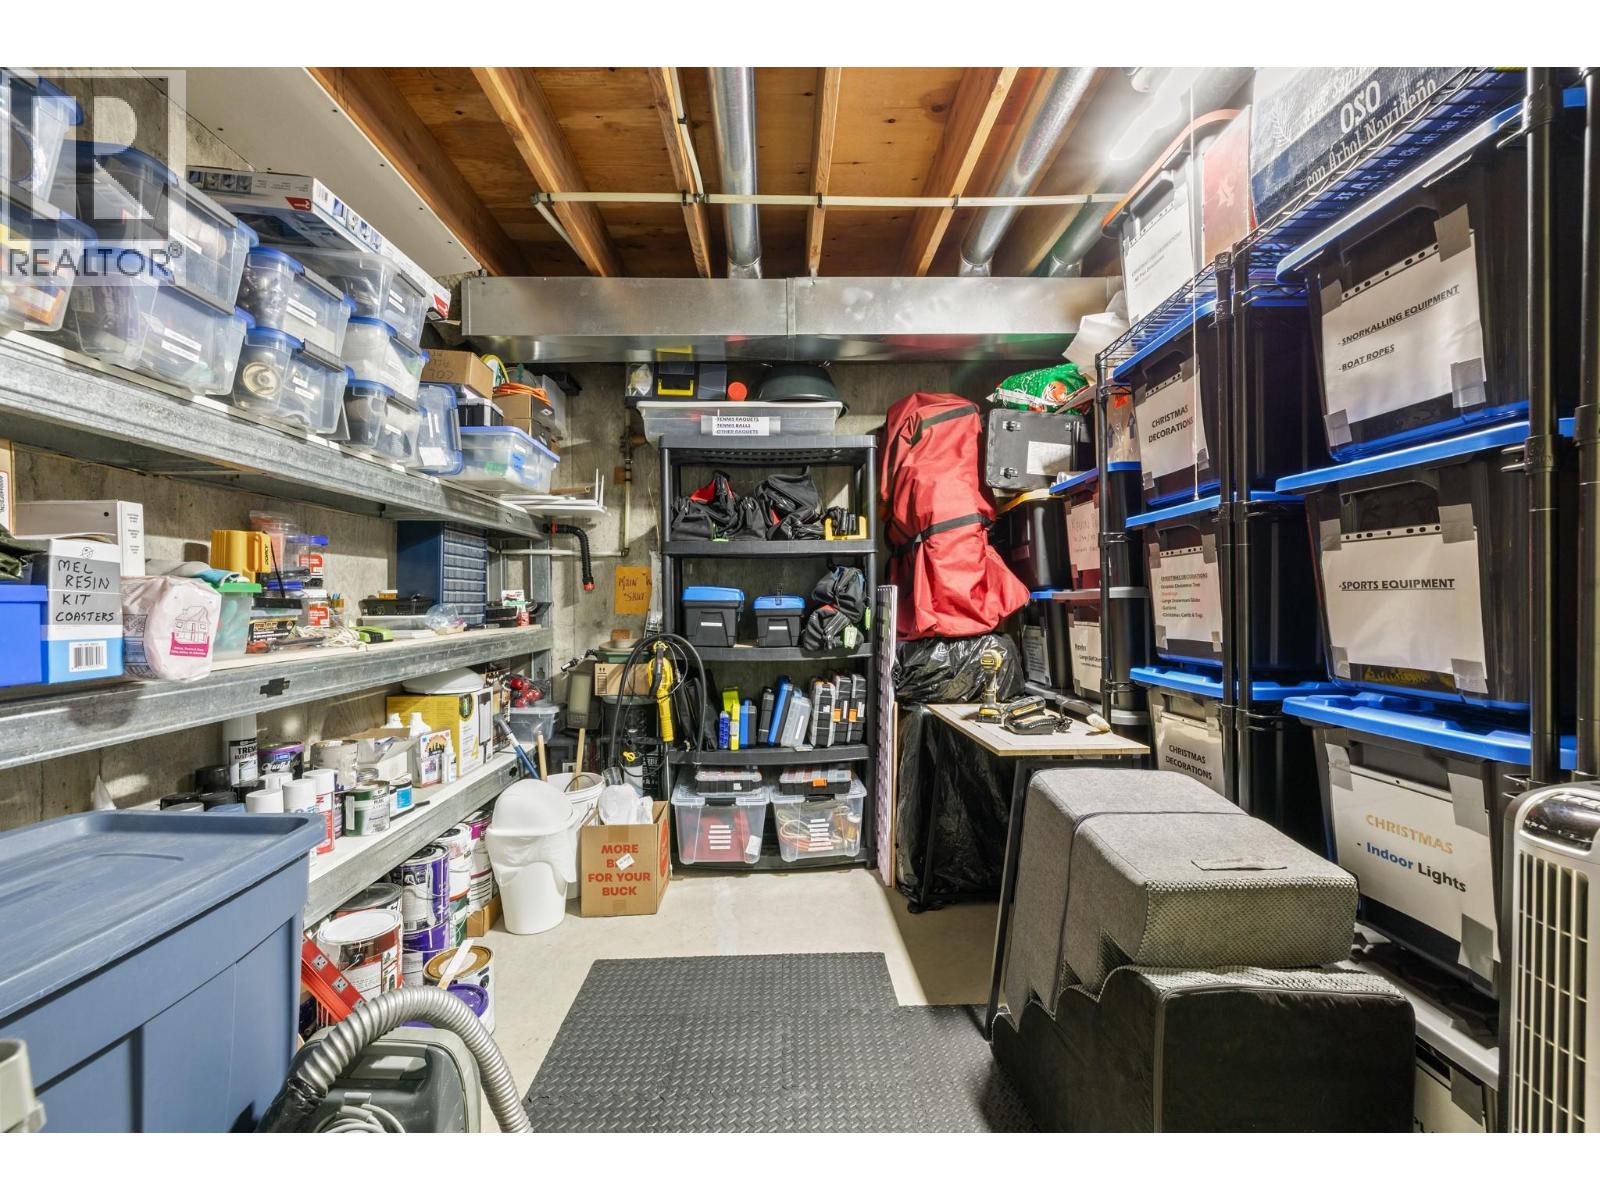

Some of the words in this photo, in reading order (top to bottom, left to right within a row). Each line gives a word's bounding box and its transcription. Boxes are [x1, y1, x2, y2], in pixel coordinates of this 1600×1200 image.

[1340, 80, 1381, 133] OSO
[1306, 164, 1326, 187] con
[1363, 79, 1437, 142] Navideño
[1404, 284, 1460, 318] EQUIPMENT
[1367, 344, 1395, 362] ROPES
[1151, 404, 1189, 429] CHRISTMAS
[1148, 416, 1194, 444] DECORATIONS
[57, 559, 94, 575] MEL
[65, 575, 110, 590] RESIN
[1381, 578, 1455, 590] EQUIPMENT
[62, 594, 91, 605] KIT
[55, 611, 115, 623] COASTERS
[1168, 744, 1206, 765] CHRISTMAS
[1165, 756, 1213, 781] DECORATIONS
[1365, 814, 1453, 854] CHRISTMAS
[601, 844, 639, 854] MORE
[588, 873, 613, 882] FOR
[616, 872, 651, 882] YOUR
[1366, 842, 1413, 870] Indoor
[1418, 862, 1467, 893] Lights
[602, 886, 637, 896] BUCK
